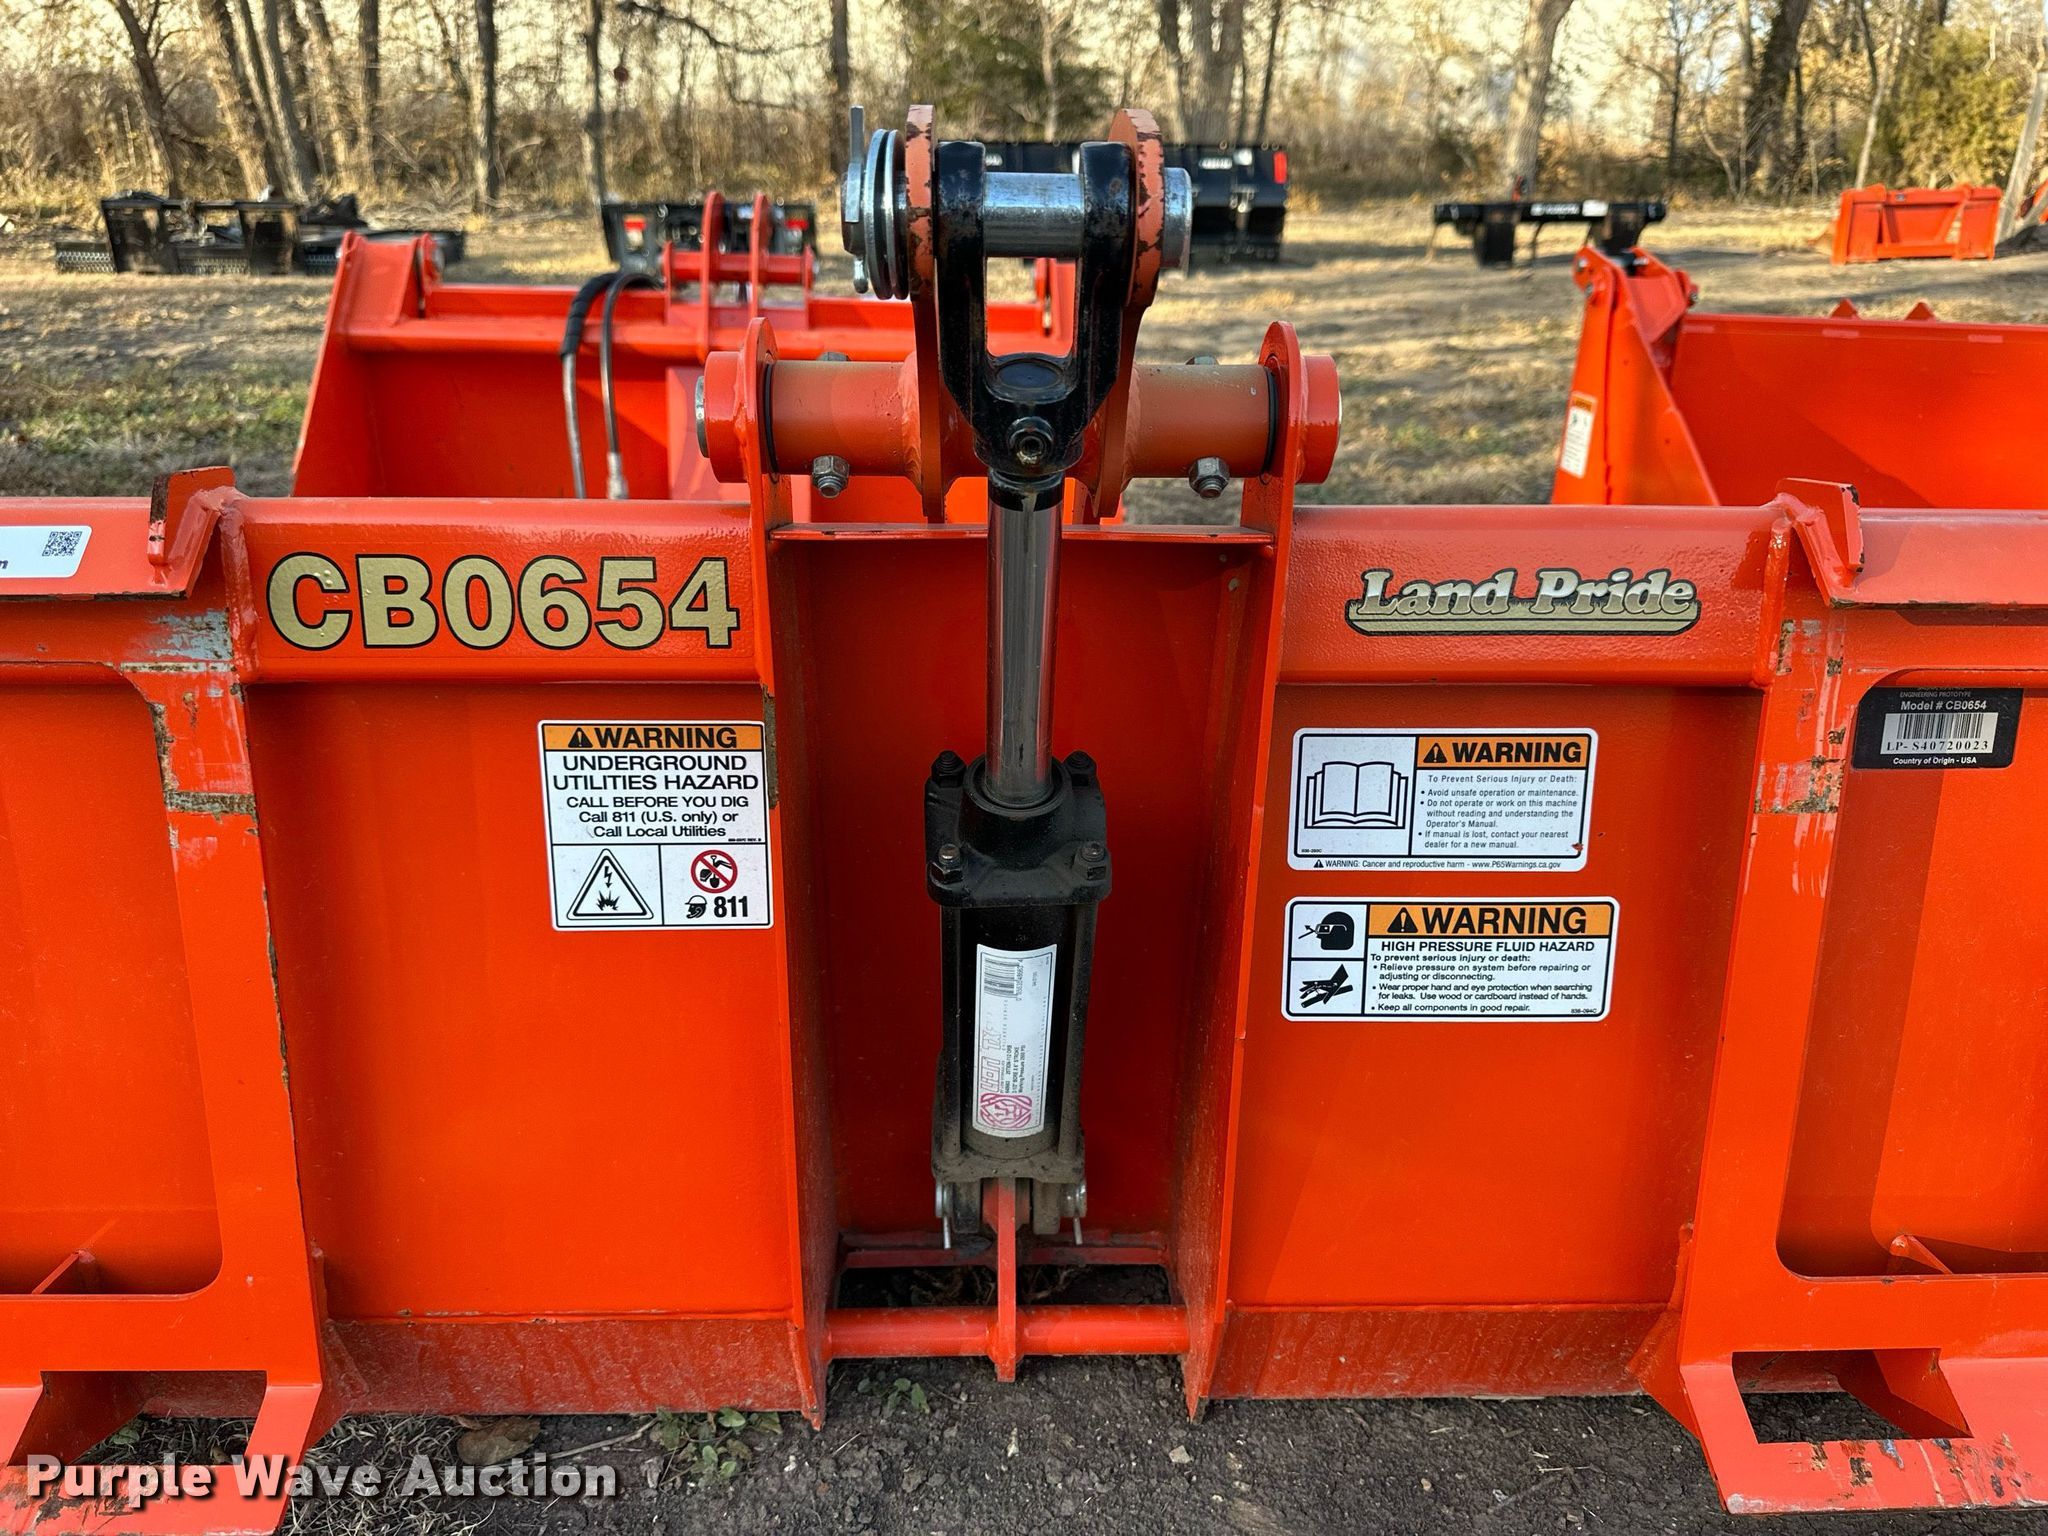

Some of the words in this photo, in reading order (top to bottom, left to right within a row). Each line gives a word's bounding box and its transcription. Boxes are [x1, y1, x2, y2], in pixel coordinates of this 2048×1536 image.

[1357, 568, 1518, 615] Land
[1530, 568, 1697, 615] Pride
[266, 552, 740, 650] CB0654
[1900, 701, 1933, 711] Model
[1935, 701, 1943, 710] #
[1945, 700, 1987, 710] CB0654
[594, 727, 738, 749] WARNING
[1451, 742, 1582, 763] WARNING
[563, 755, 747, 771] UNDERGROUND
[1893, 757, 1922, 766] Country
[1932, 757, 1955, 765] Origin
[553, 775, 657, 791] UTILITIES
[664, 774, 759, 790] HAZARD
[1428, 775, 1439, 783] To
[1441, 775, 1474, 783] Prevent
[1476, 775, 1508, 783] Serious
[1511, 775, 1536, 784] Injury
[1550, 775, 1577, 783] Death:
[1427, 789, 1449, 797] Avoid
[1451, 789, 1477, 797] unsafe
[1479, 789, 1515, 797] operation
[1527, 789, 1579, 797] maintenance.
[566, 796, 609, 808] CALL
[613, 796, 679, 808] BEFORE
[681, 796, 716, 808] YOU
[721, 796, 749, 807] DIG
[1427, 799, 1438, 807] Do
[1439, 799, 1453, 807] not
[1454, 800, 1484, 808] operate
[1496, 799, 1515, 807] work
[1528, 799, 1543, 807] this
[1545, 799, 1578, 807] machine
[579, 811, 608, 823] Call
[612, 811, 636, 823] 811
[641, 811, 677, 824] (U.S.
[681, 811, 718, 825] only)
[722, 814, 739, 823] or
[1457, 810, 1487, 819] reading
[1504, 810, 1559, 819] understanding
[1425, 819, 1466, 829] Operator's
[1468, 820, 1498, 828] Manual.
[593, 826, 623, 838] Call
[626, 826, 667, 837] Local
[672, 826, 727, 837] Utilities
[1424, 830, 1431, 838] If
[1433, 830, 1461, 838] manual
[1462, 830, 1470, 838] is
[1471, 830, 1489, 839] lost,
[1490, 830, 1519, 838] contact
[1521, 831, 1538, 839] your
[1325, 860, 1360, 868] WARNING:
[1361, 860, 1386, 868] Cancer
[1387, 860, 1401, 868] and
[1402, 860, 1445, 869] reproductive
[713, 895, 749, 918] 811
[1422, 907, 1587, 935] WARNING
[1381, 941, 1415, 952] HIGH
[1419, 941, 1493, 952] PRESSURE
[1496, 941, 1536, 952] FLUID
[1539, 941, 1595, 952] HAZARD
[1370, 953, 1382, 962] To
[1384, 954, 1420, 963] prevent
[1422, 954, 1457, 962] serious
[1459, 954, 1486, 963] injury
[1500, 954, 1531, 962] death:
[1379, 963, 1414, 971] Relieve
[1472, 964, 1505, 973] system
[1539, 964, 1579, 973] repairing
[1379, 973, 1419, 981] adjusting
[1432, 973, 1495, 981] disconnecting.
[1379, 983, 1401, 991] Wear
[1401, 984, 1429, 992] proper
[1430, 983, 1452, 991] hand
[1453, 983, 1469, 991] and
[1470, 984, 1486, 992] eye
[1487, 984, 1529, 992] protection
[1530, 983, 1552, 991] when
[1553, 983, 1593, 992] searching
[1378, 992, 1390, 1000] for
[1391, 992, 1416, 1000] leaks.
[1420, 992, 1437, 1000] Use
[1438, 992, 1462, 1000] wood
[1474, 992, 1517, 1000] cardboard
[1518, 992, 1549, 1000] instead
[1550, 992, 1560, 1000] of
[1560, 992, 1588, 1000] hands.
[1377, 1003, 1401, 1012] Keep
[1414, 1004, 1468, 1012] components
[1469, 1003, 1478, 1011] in
[1480, 1004, 1503, 1012] good
[1504, 1004, 1530, 1012] repair.
